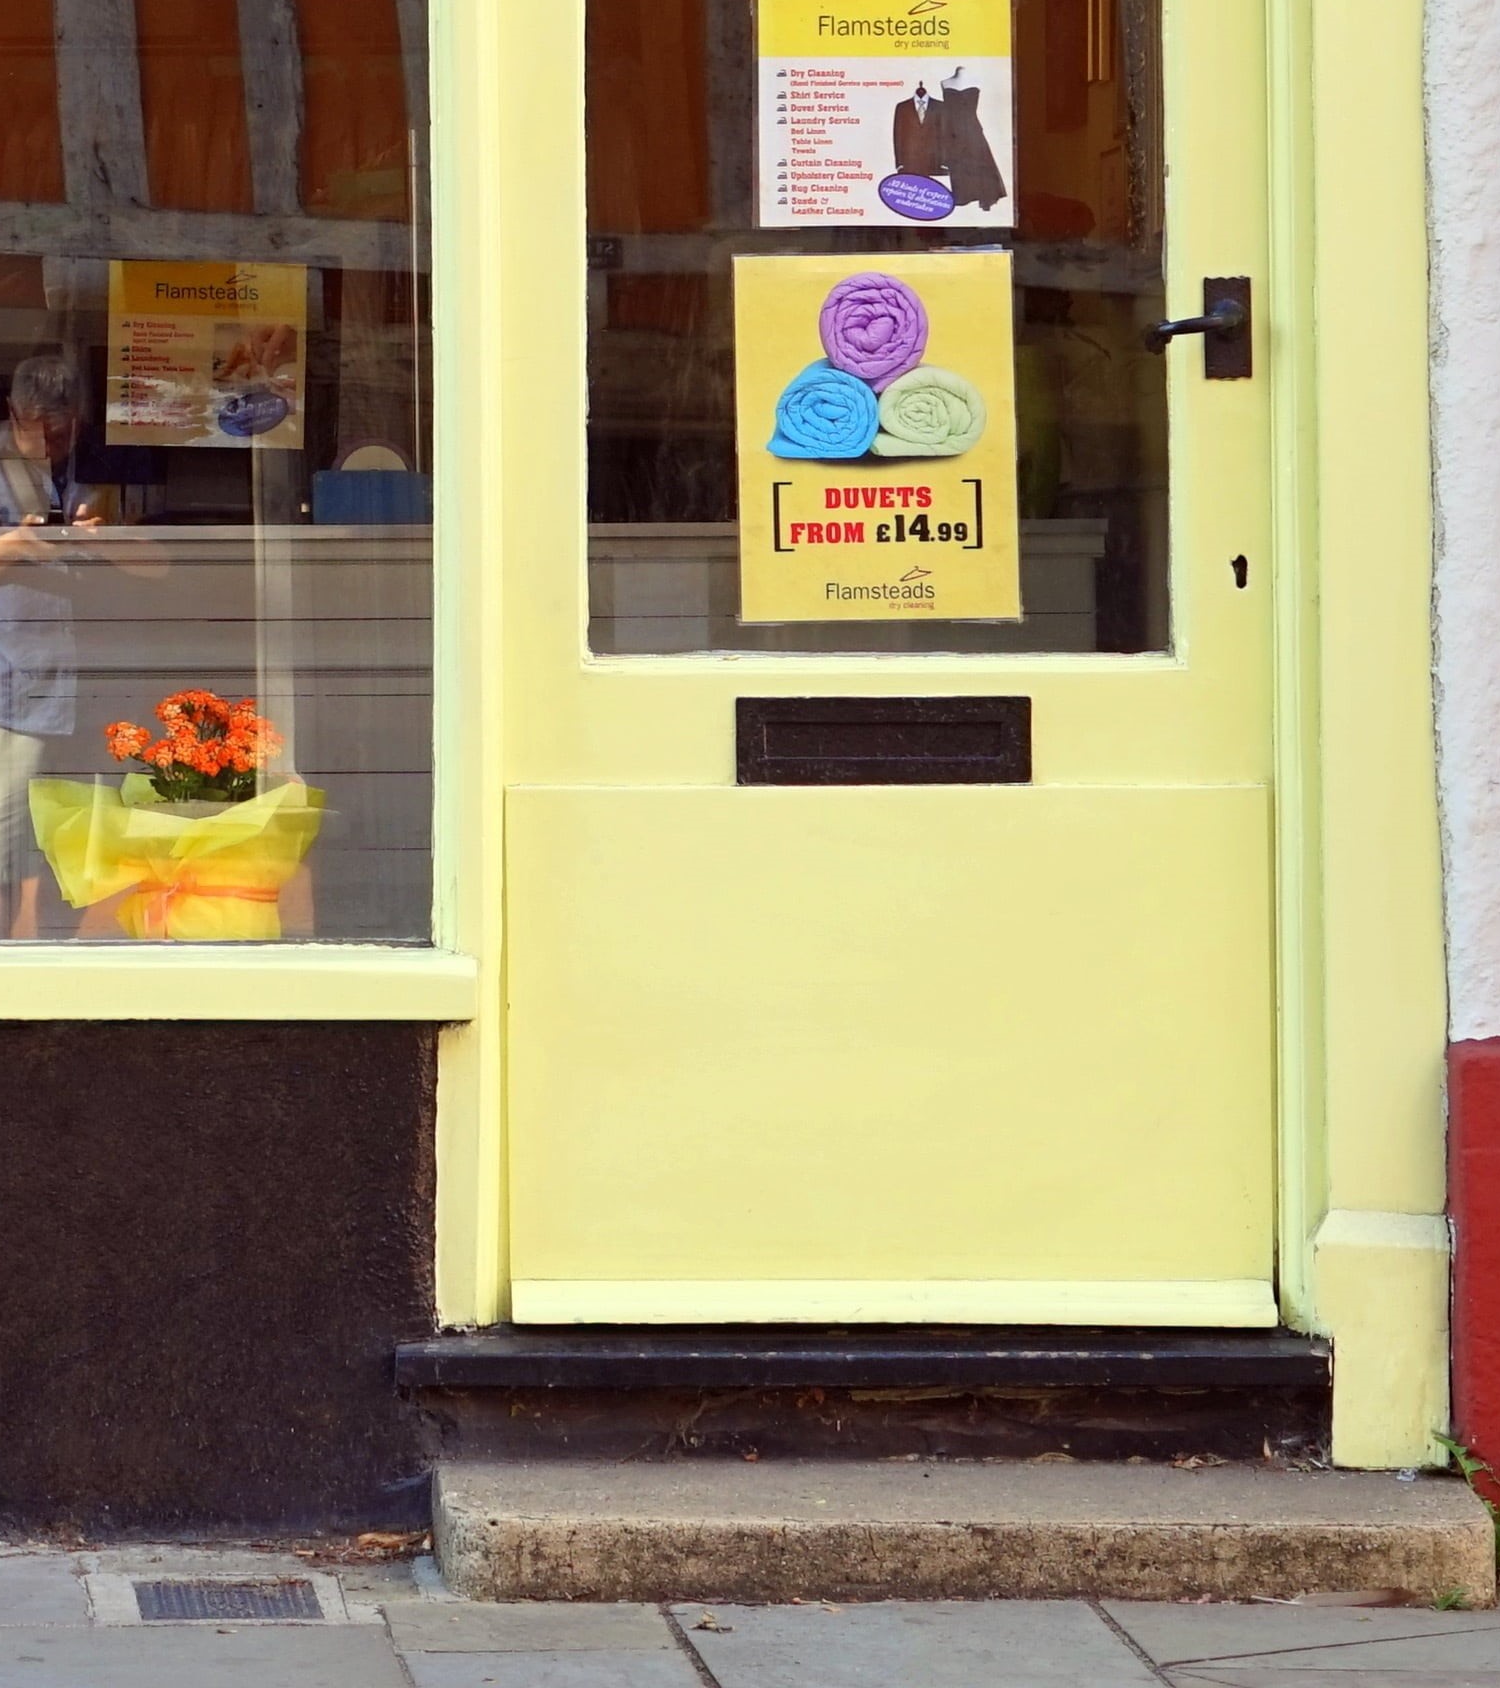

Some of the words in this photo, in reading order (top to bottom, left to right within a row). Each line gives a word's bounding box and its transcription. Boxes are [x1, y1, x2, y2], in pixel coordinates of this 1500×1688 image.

[818, 14, 951, 37] Flamsteads
[894, 39, 910, 50] dry
[911, 39, 950, 50] cleaning
[790, 69, 805, 79] Dry
[807, 69, 846, 79] Cleaning
[813, 91, 846, 99] Service
[817, 104, 850, 112] Service
[790, 116, 826, 126] Laundry
[828, 116, 861, 125] Service
[824, 158, 863, 168] Cleaning
[836, 171, 874, 181] Cleaning
[810, 184, 849, 193] Cleaning
[791, 207, 824, 215] Leather
[826, 207, 865, 216] Cleaning
[154, 282, 259, 301] Flamsteads
[824, 486, 933, 510] DUVETS
[790, 522, 865, 545] FROM
[876, 514, 968, 544] £14.99
[825, 582, 936, 600] Flamsteads
